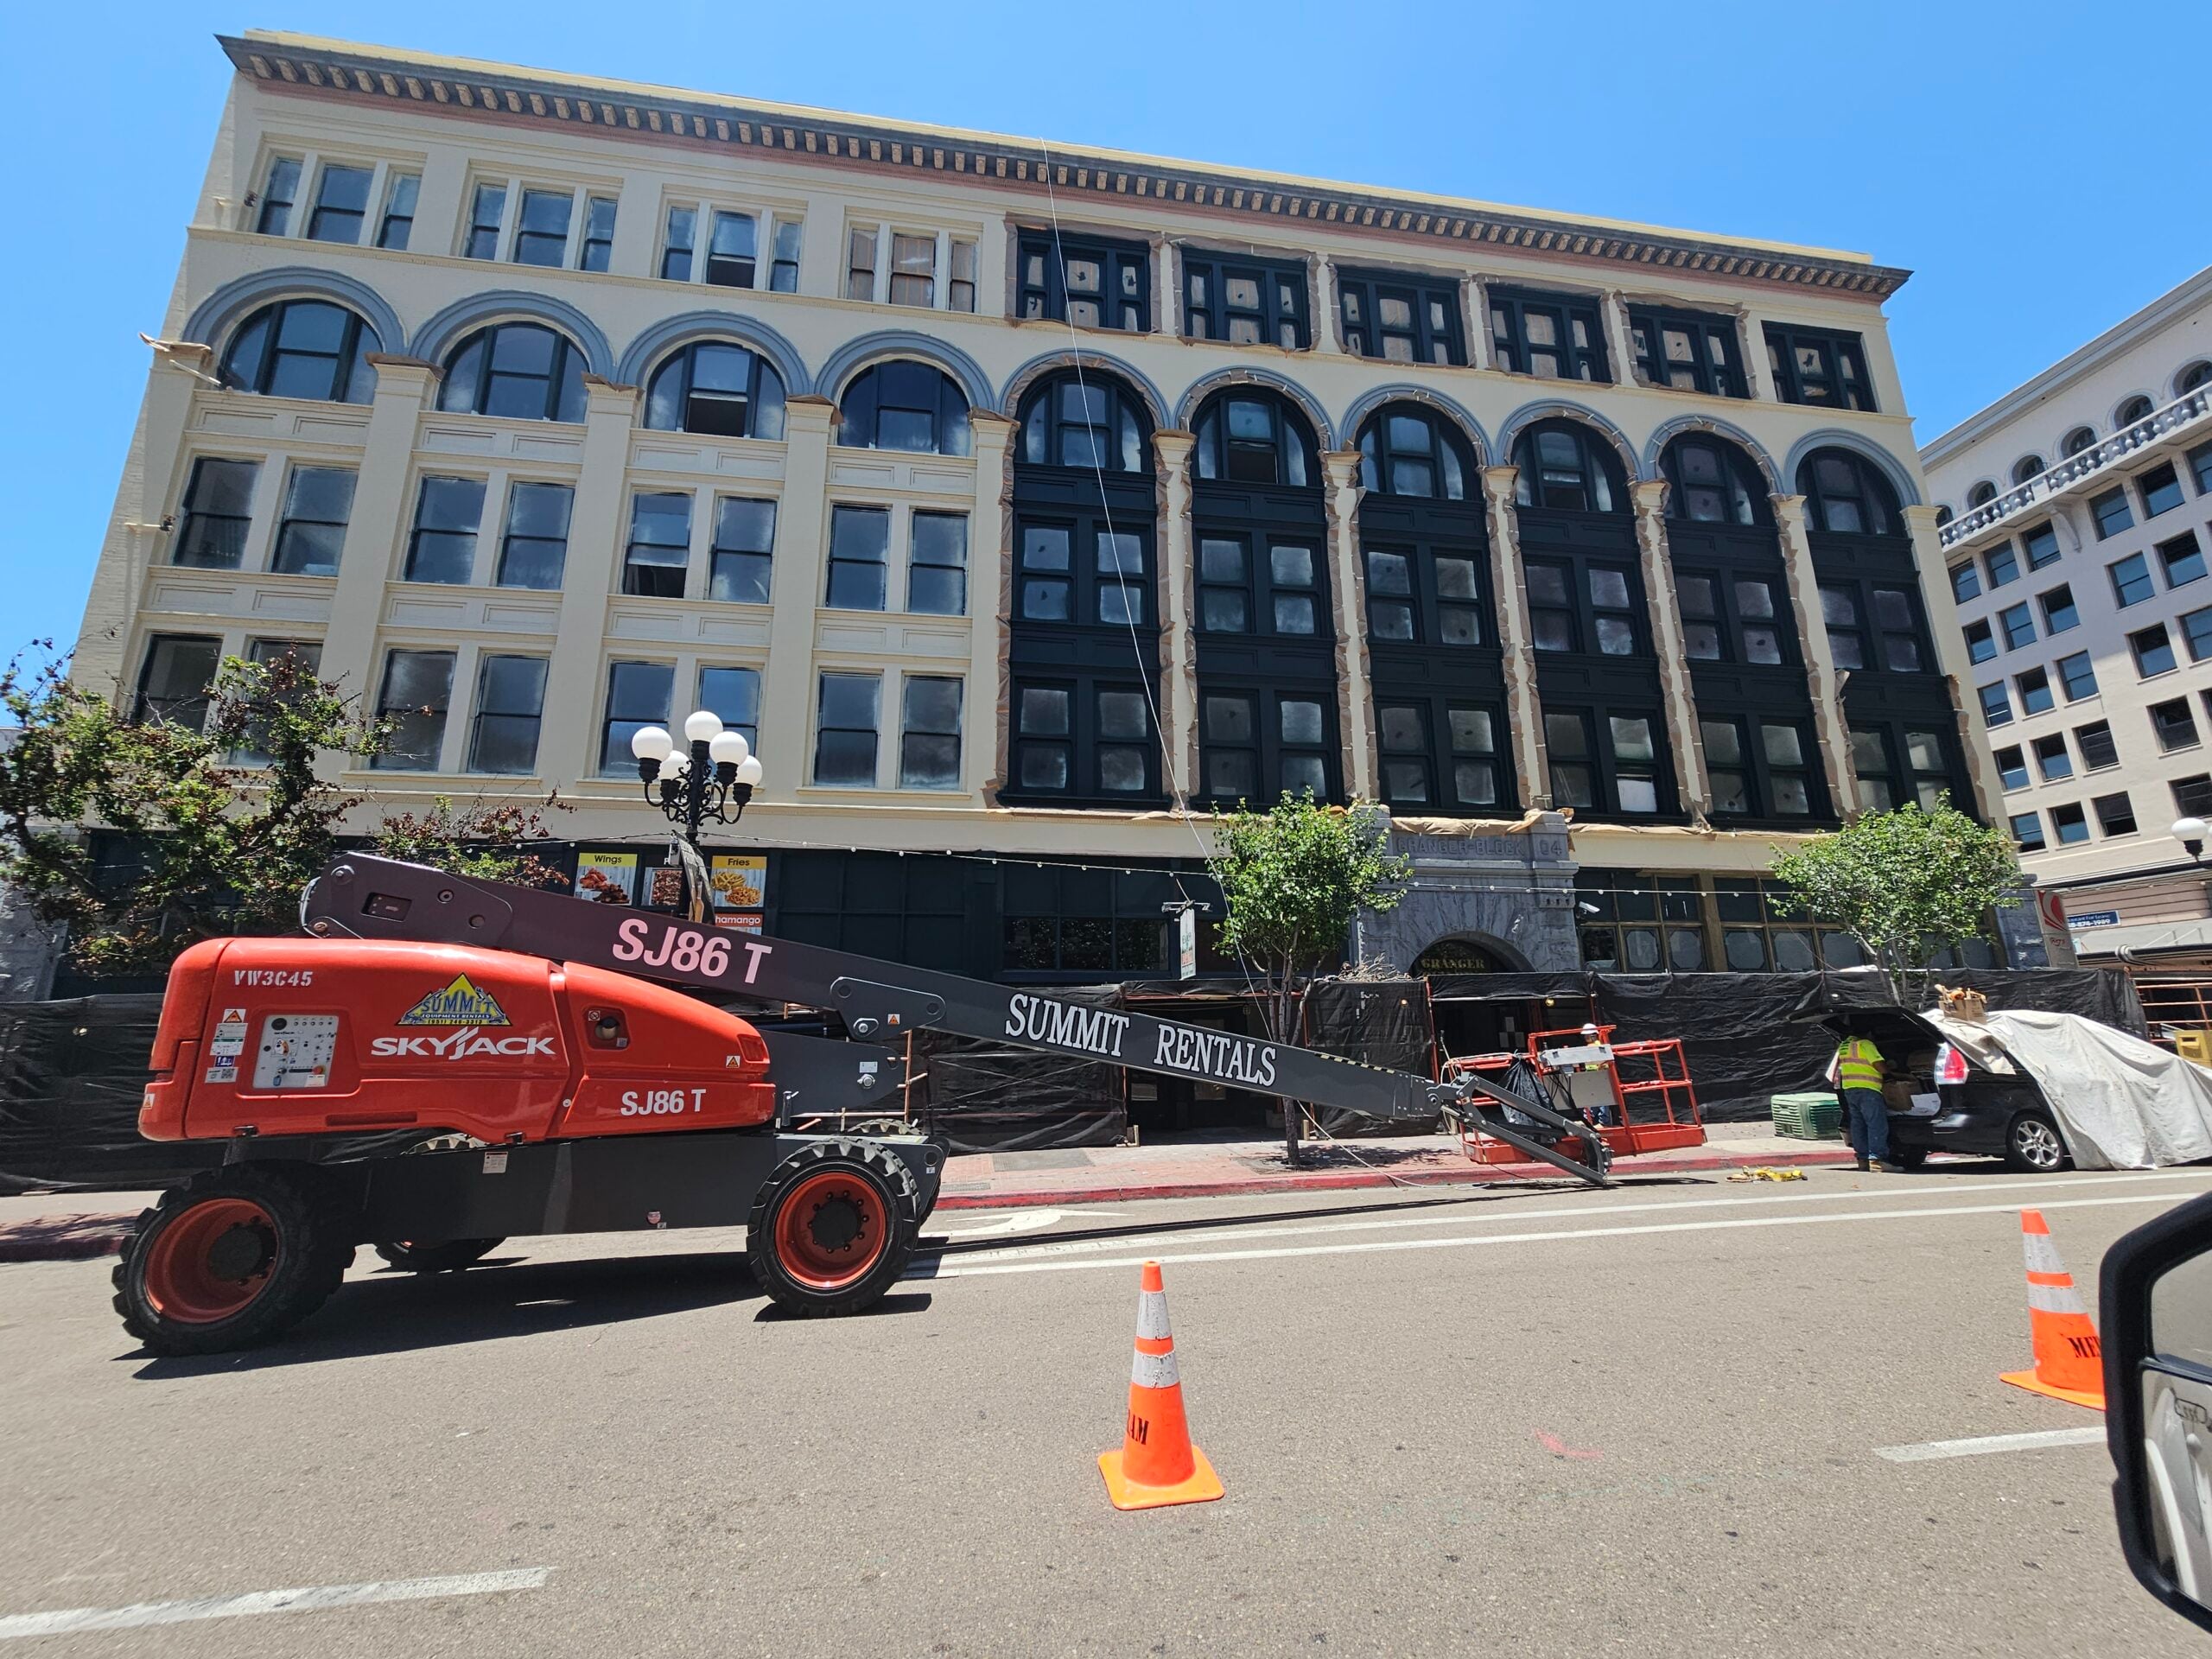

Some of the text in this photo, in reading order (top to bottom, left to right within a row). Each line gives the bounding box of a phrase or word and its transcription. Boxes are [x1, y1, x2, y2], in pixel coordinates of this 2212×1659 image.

[594, 855, 622, 866] Wings
[728, 857, 750, 866] Fries
[715, 915, 761, 926] hamango
[612, 918, 772, 984] SJ86 T
[1421, 958, 1485, 969] GRANGER
[421, 989, 493, 1012] SUMMIT
[371, 1027, 556, 1060] SKYJACK
[1005, 993, 1277, 1087] SUMMIT RENTALS
[620, 1089, 707, 1116] SJ86 T
